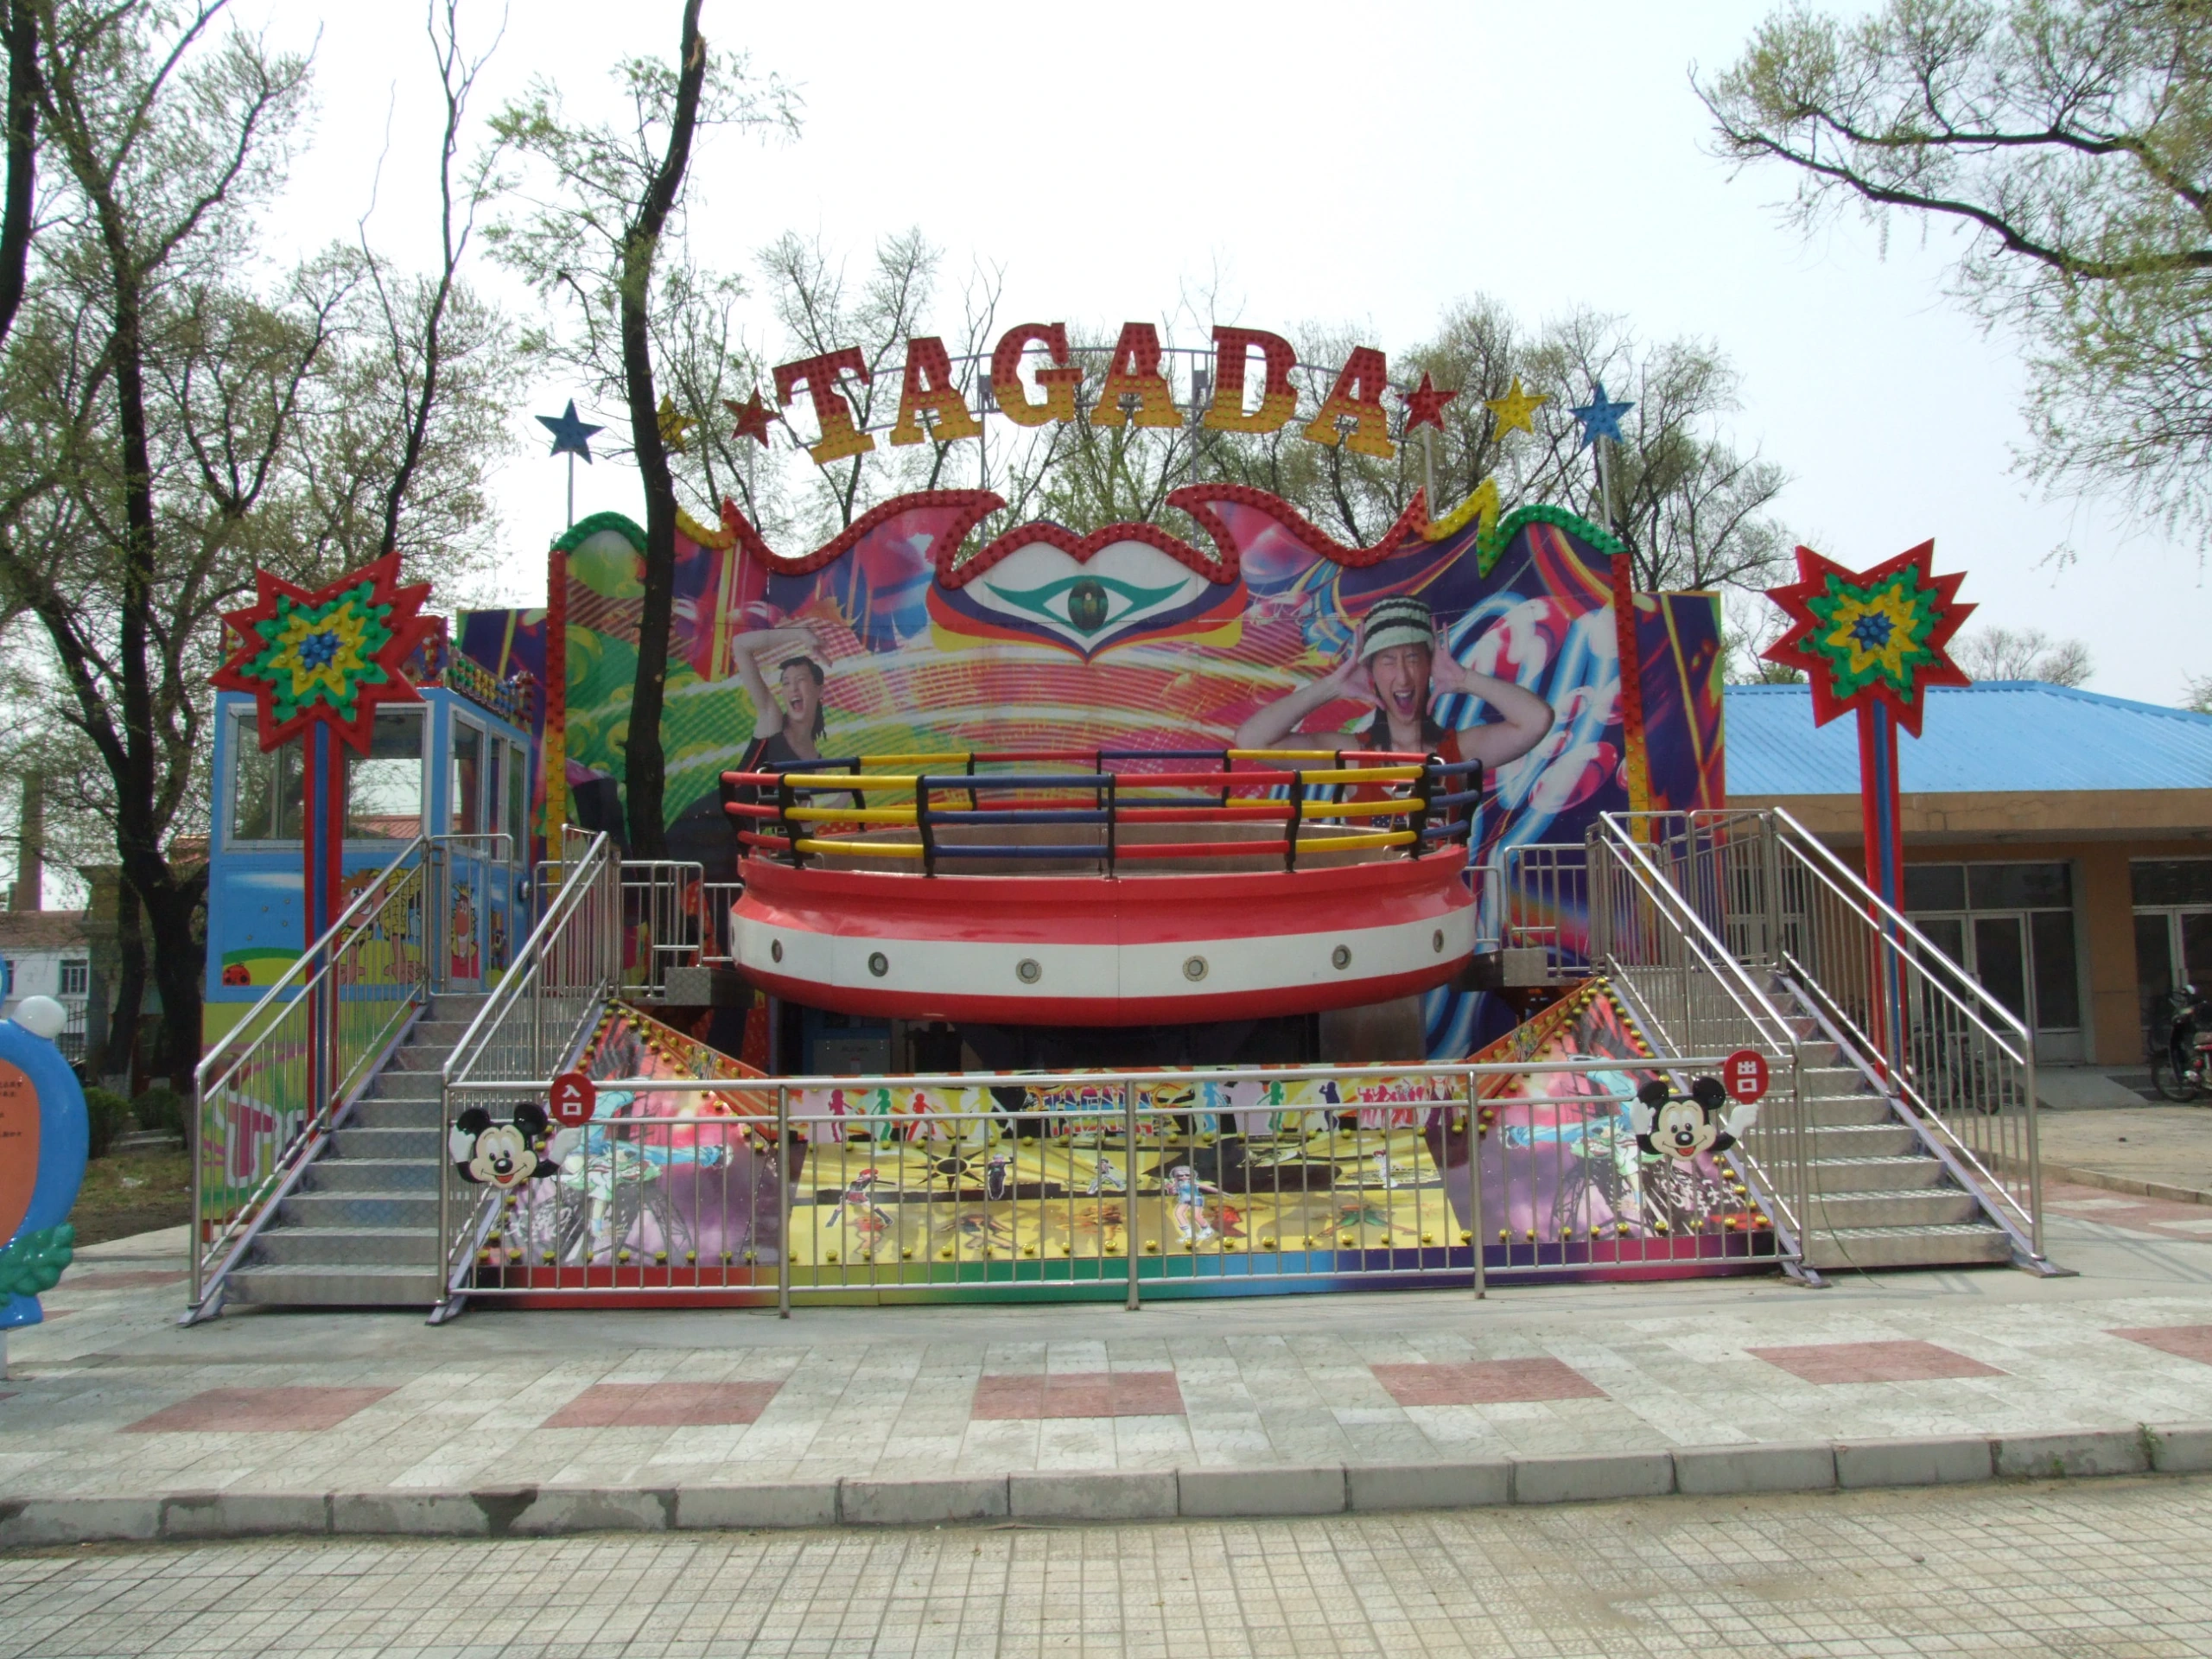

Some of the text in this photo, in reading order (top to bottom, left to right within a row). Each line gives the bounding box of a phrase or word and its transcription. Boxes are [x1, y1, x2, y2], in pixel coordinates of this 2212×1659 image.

[772, 321, 1395, 464] TAGADA
[1737, 1061, 1758, 1093] 出口
[562, 1084, 582, 1116] 入口
